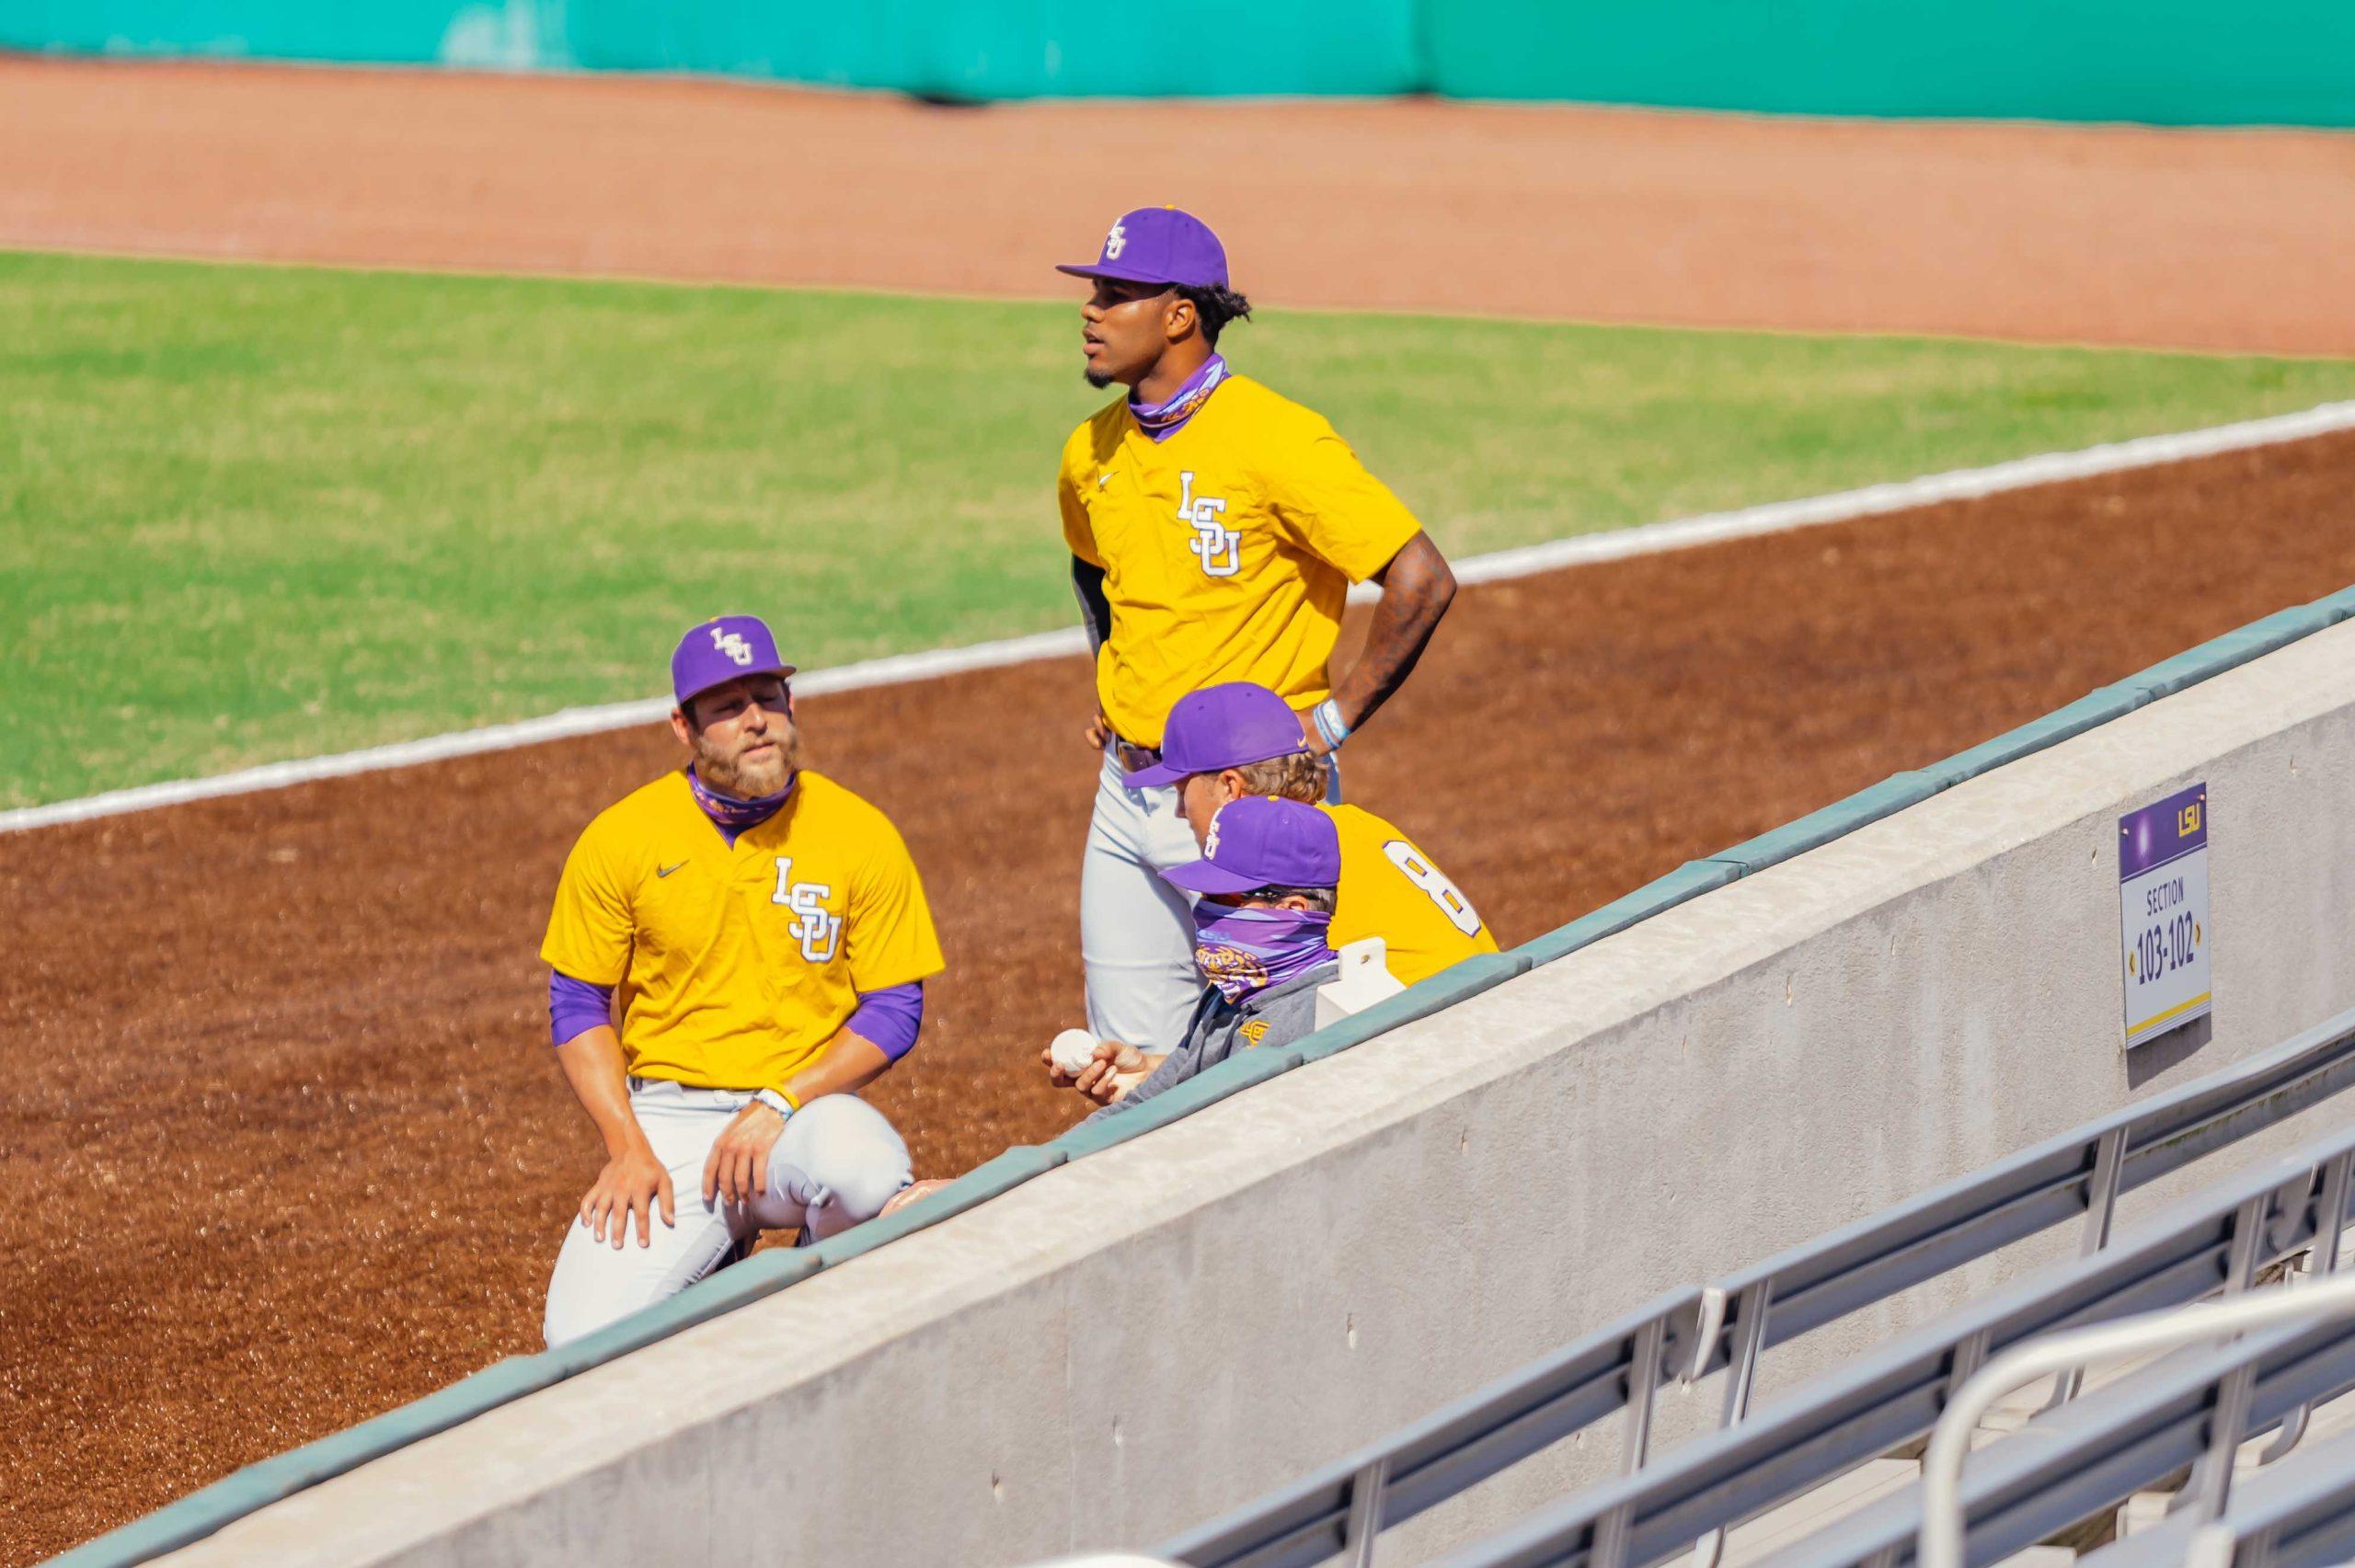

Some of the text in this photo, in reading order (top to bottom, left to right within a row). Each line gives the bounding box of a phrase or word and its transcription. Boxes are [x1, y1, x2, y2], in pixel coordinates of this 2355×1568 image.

[1177, 470, 1241, 578] LSU
[710, 626, 752, 666] LSU
[2177, 802, 2200, 838] LSU
[772, 855, 843, 964] LSU
[1382, 841, 1481, 938] 8
[2147, 876, 2184, 916] SECTION
[2137, 910, 2194, 985] 103-102
